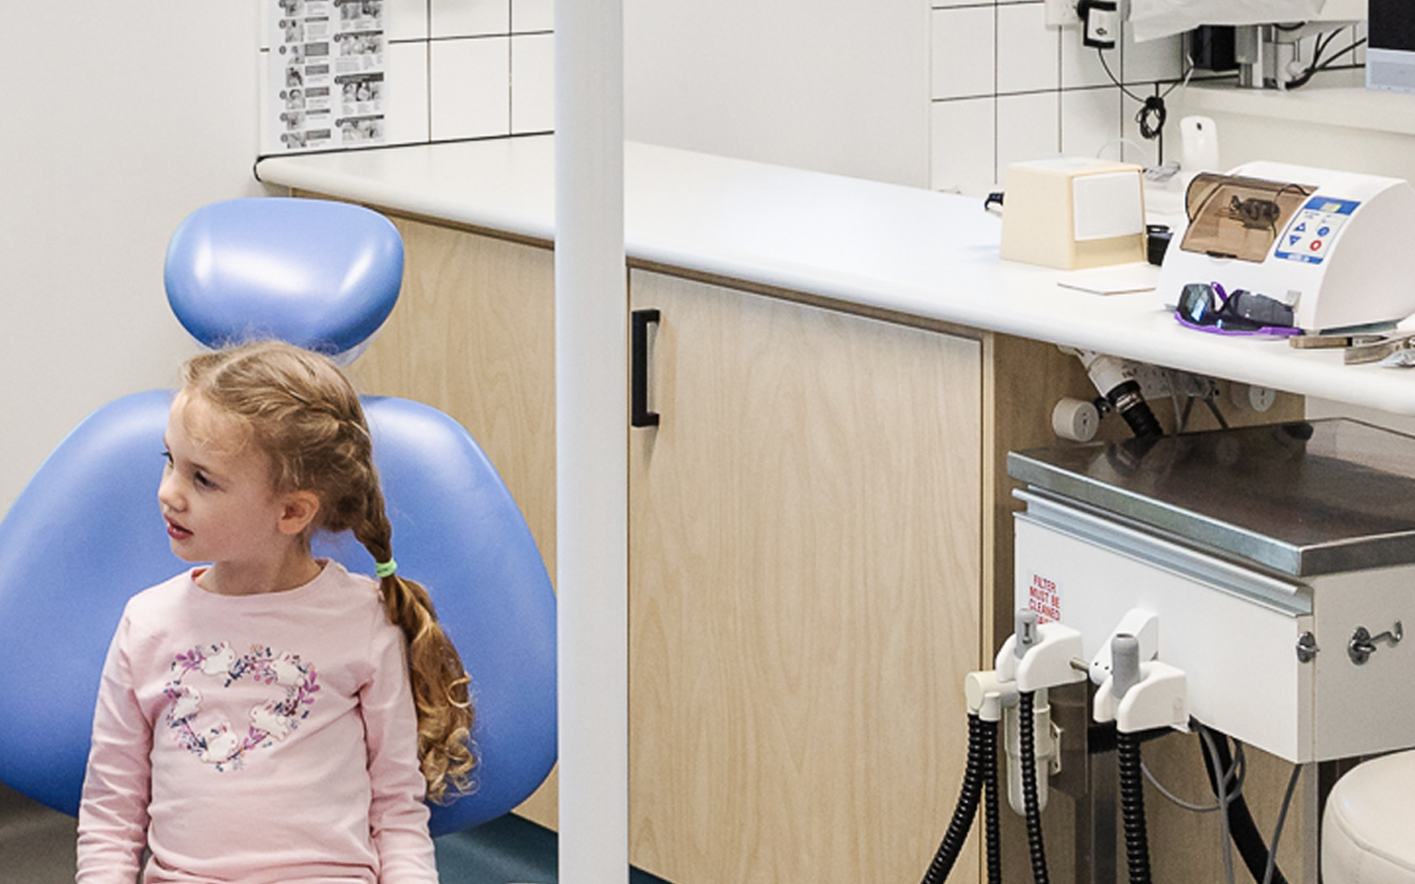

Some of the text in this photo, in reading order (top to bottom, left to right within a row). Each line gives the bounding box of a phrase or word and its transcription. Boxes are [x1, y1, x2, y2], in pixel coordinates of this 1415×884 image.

[1033, 574, 1056, 593] FILTER
[1029, 586, 1060, 608] MUST BE
[1029, 598, 1060, 621] CLEANED
